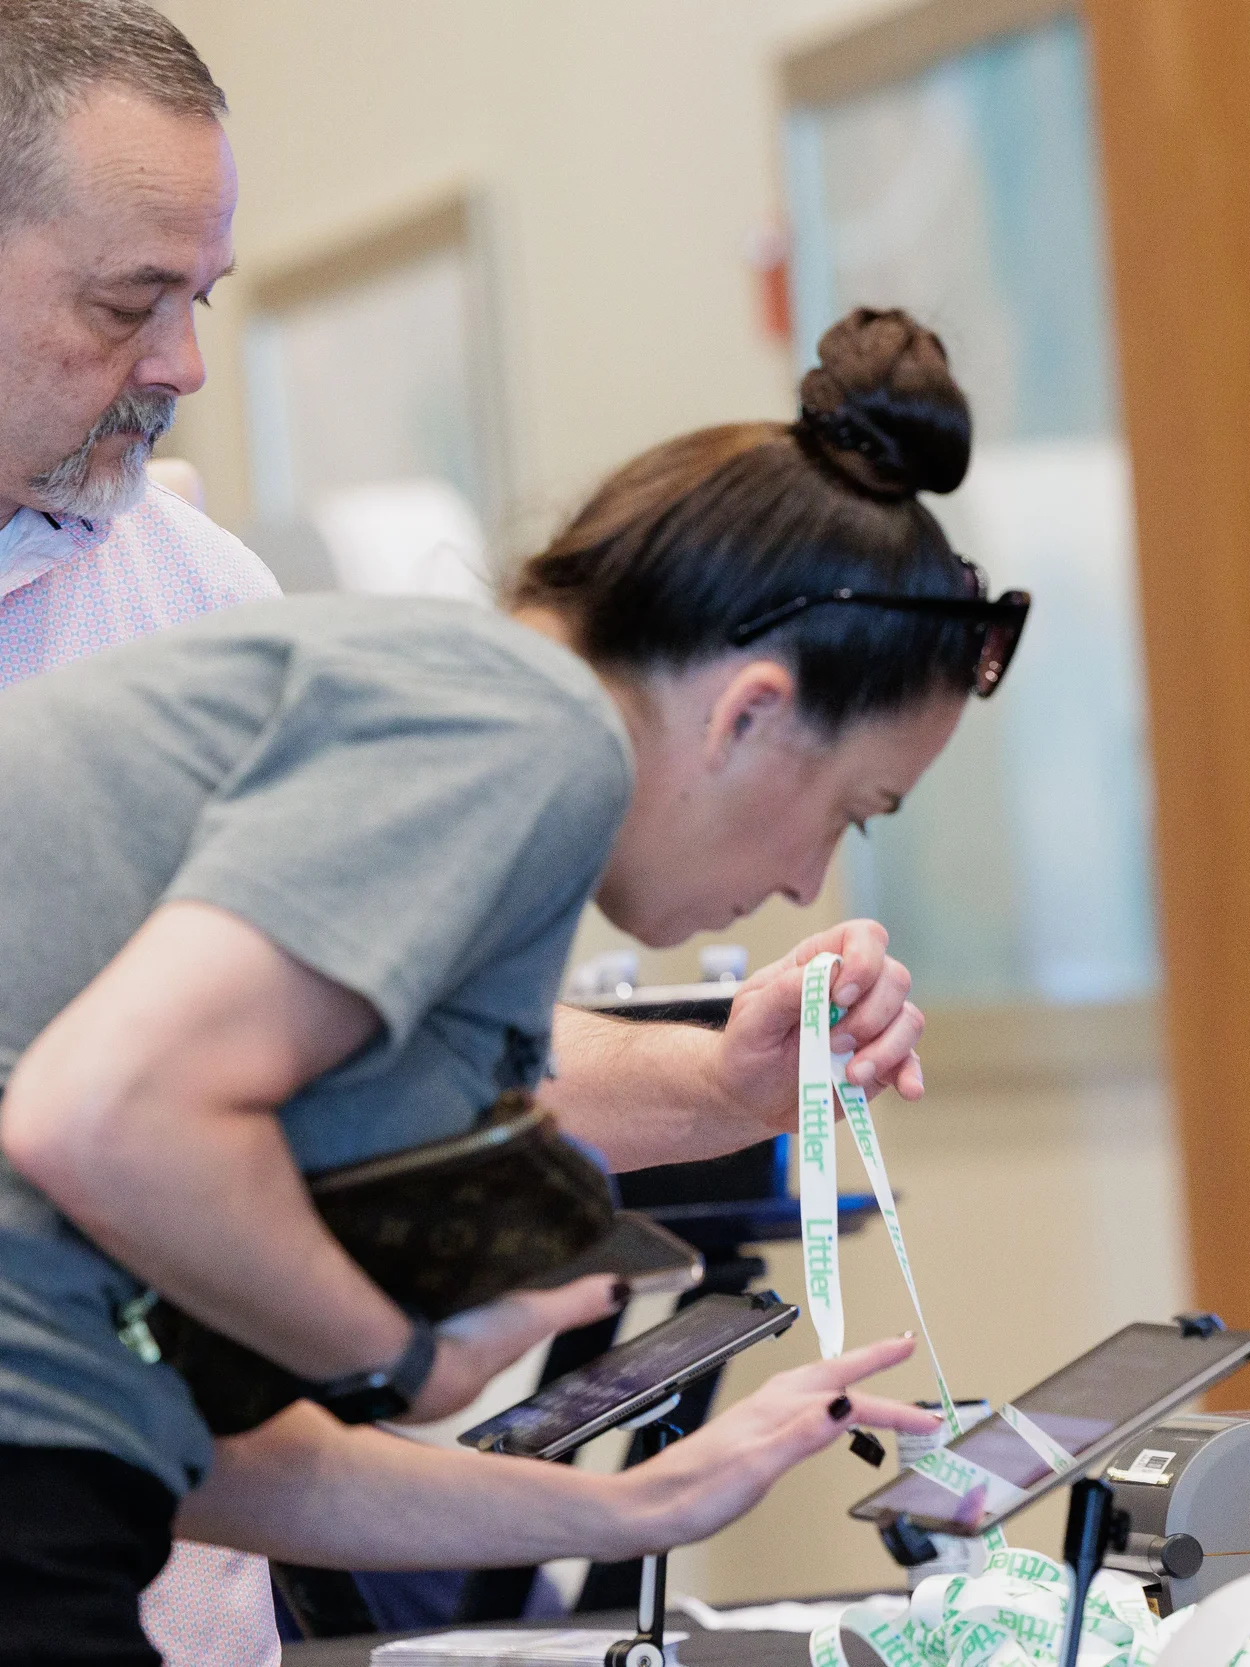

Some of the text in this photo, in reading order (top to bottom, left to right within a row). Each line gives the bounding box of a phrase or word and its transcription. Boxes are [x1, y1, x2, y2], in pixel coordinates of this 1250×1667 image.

[804, 964, 827, 1038] ittler
[803, 1081, 828, 1174] Littler
[839, 1081, 879, 1168] Littler
[806, 1217, 833, 1309] Littler
[983, 1552, 1060, 1582] Littler
[993, 1609, 1058, 1649] ittler
